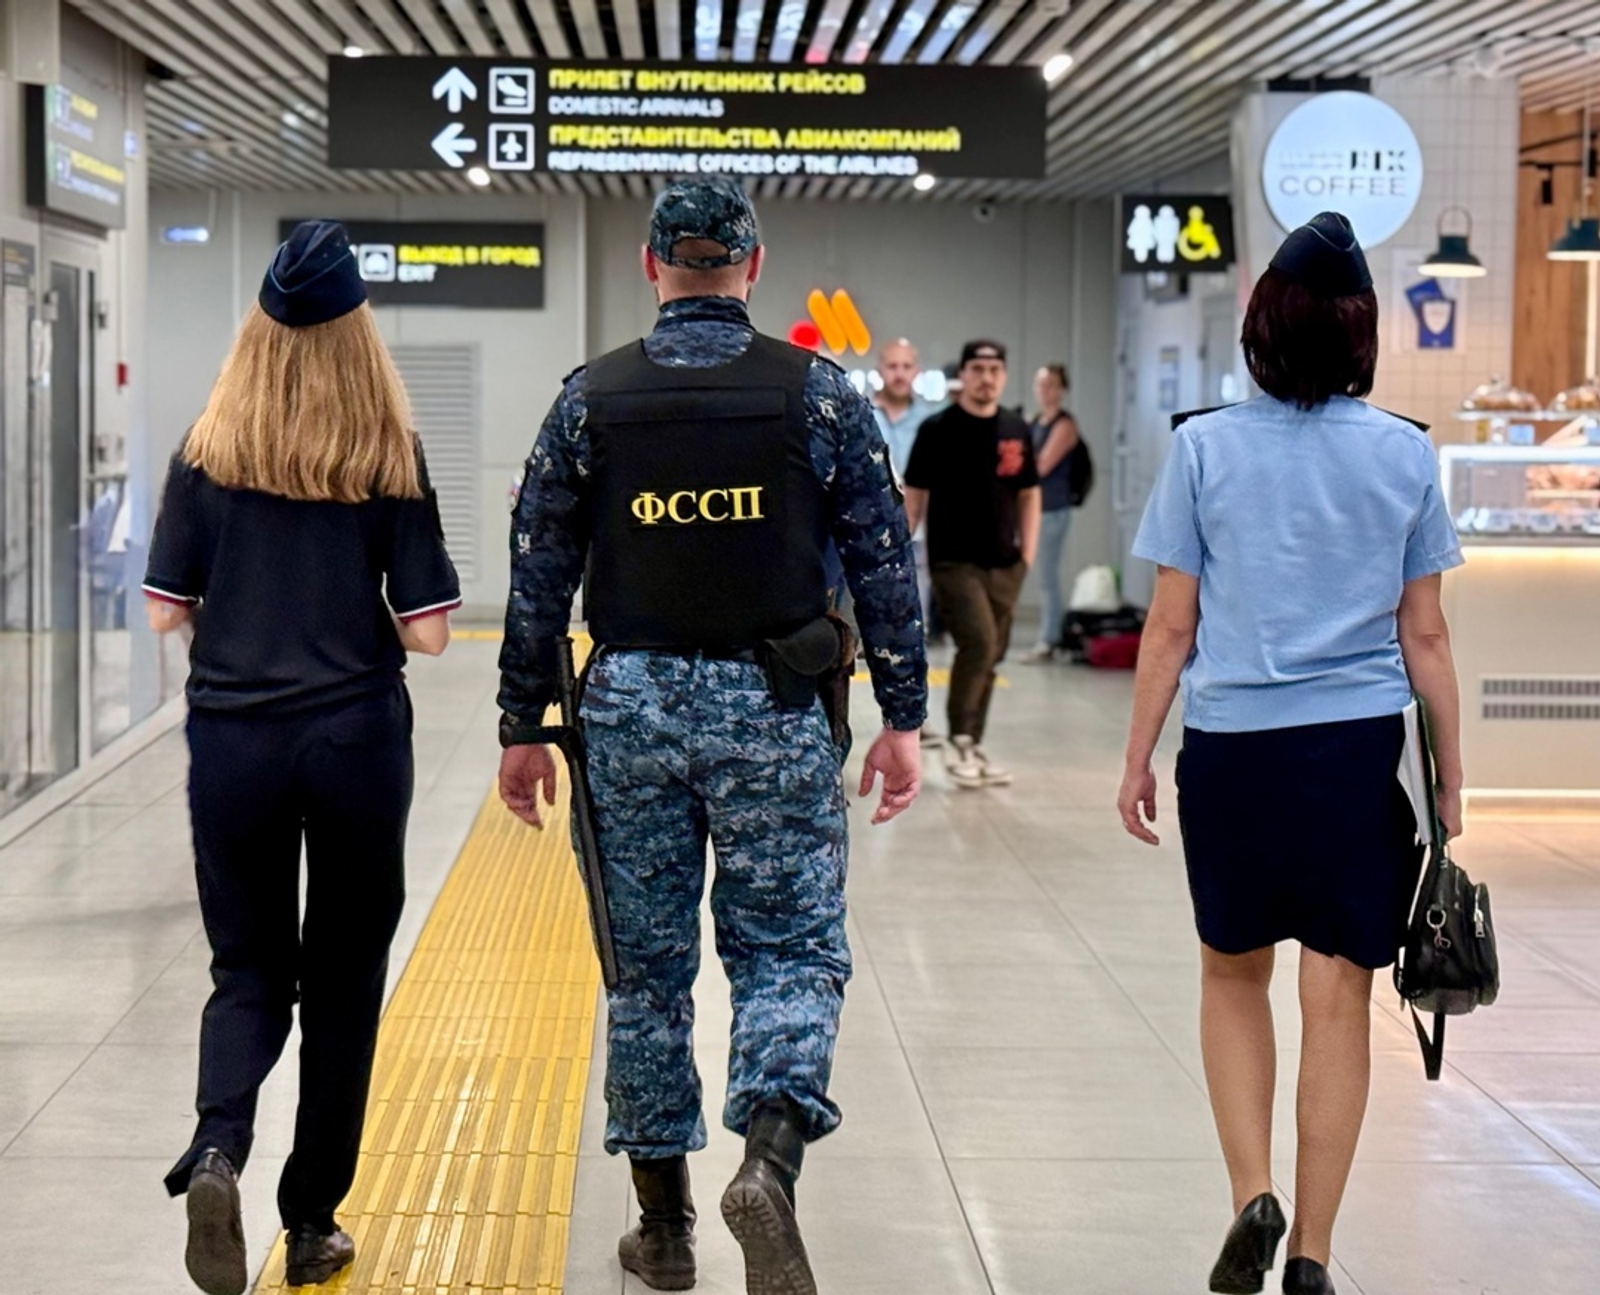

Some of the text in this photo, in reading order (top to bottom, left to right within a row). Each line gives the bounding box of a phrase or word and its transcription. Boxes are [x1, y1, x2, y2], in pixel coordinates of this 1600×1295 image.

[549, 69, 866, 93] ПРИЛЕТ ВНУТРЕННИХ РЕЙСОВ
[548, 96, 724, 117] DOMESTIC ARRIVALS
[549, 125, 961, 151] ПРЕДСТАВИТЕЛЬСТВА АВИАКОМПАНИЙ
[548, 152, 918, 175] REPRESENTATIVE OFFICES OF THE AIRLINES
[1279, 175, 1406, 197] COFFEE
[631, 486, 765, 525] ФССП
